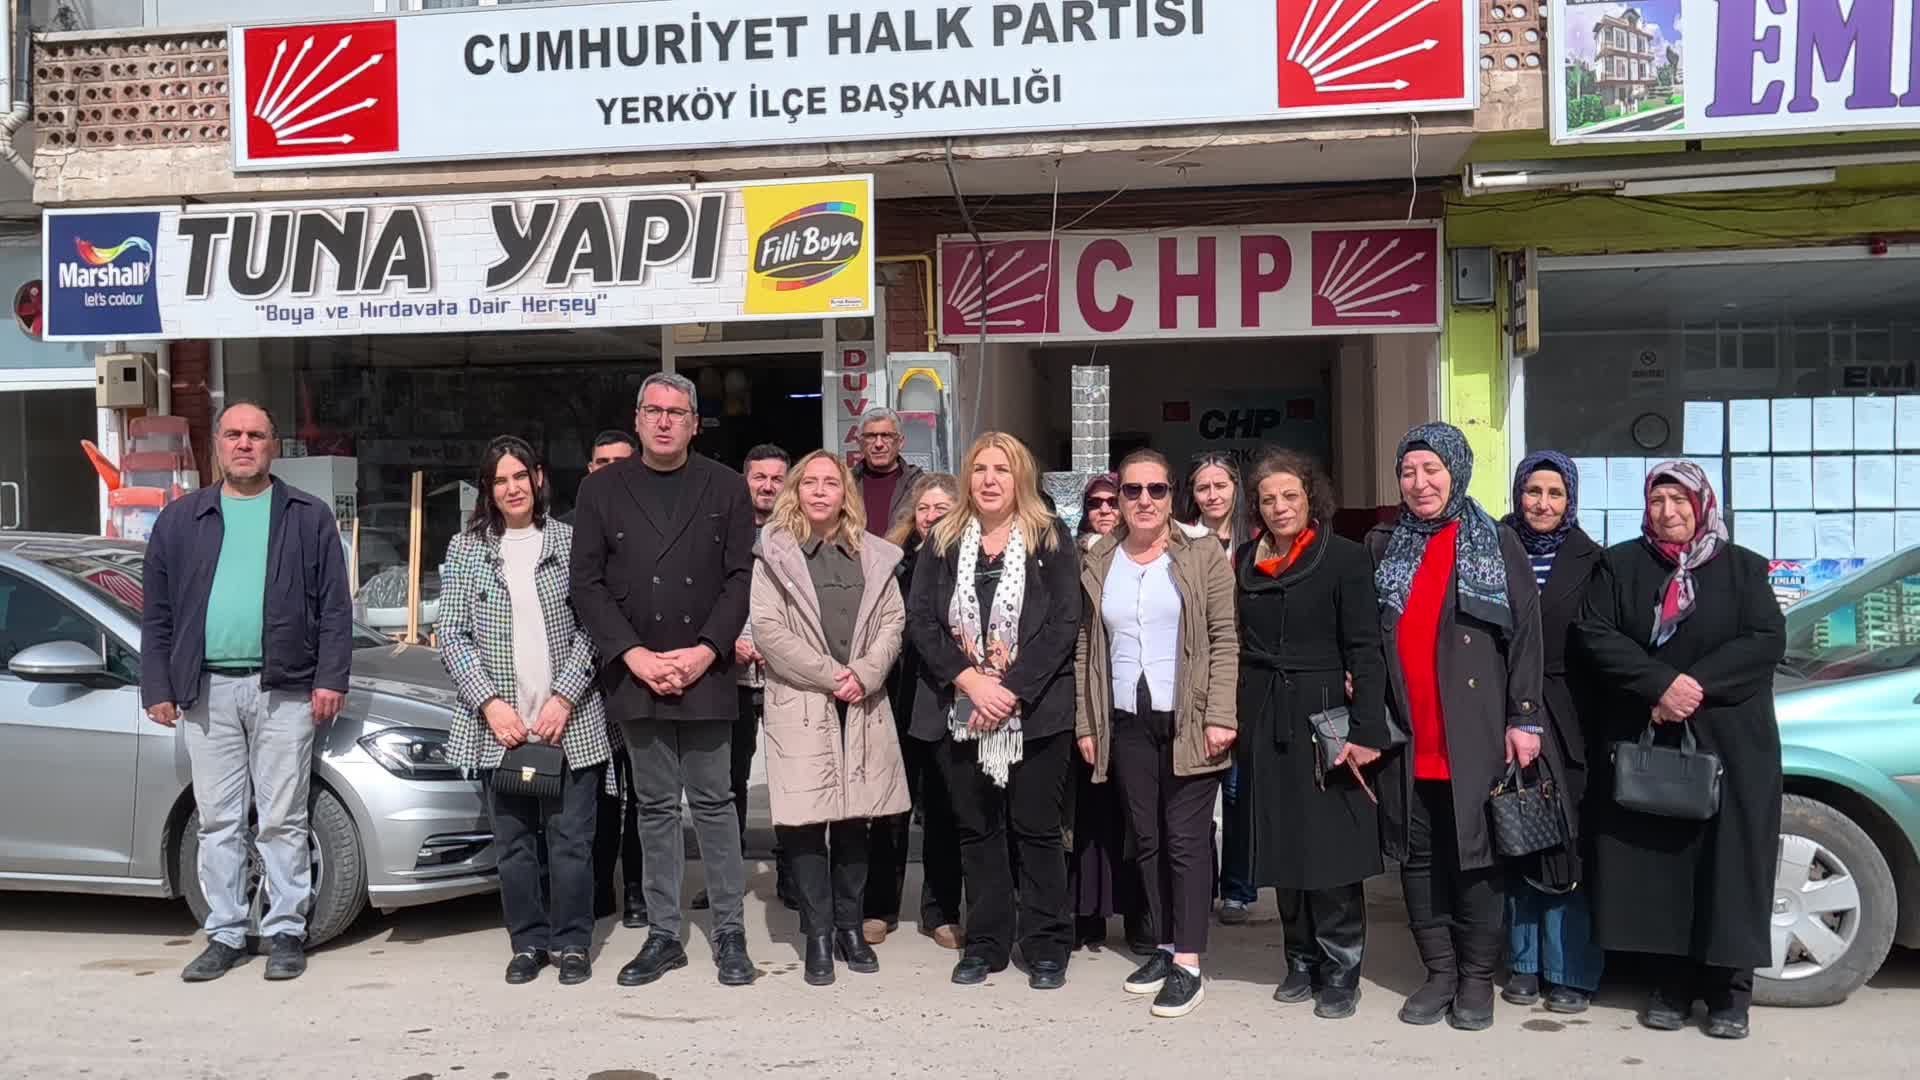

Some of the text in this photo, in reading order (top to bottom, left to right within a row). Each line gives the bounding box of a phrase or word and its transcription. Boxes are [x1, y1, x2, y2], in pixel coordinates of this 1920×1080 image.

[464, 12, 808, 75] CUMHURİYET
[828, 6, 974, 55] HALK
[596, 68, 1062, 125] YERKÖY İLÇE BAŞKANLIĞI
[177, 193, 726, 299] TUNA YAPI
[761, 226, 859, 267] Filli Boya
[58, 261, 145, 288] Marshall
[1076, 234, 1293, 333] CHP
[84, 291, 144, 306] let's colour
[326, 305, 349, 319] ve
[360, 300, 458, 318] Hırdavata
[470, 297, 511, 315] Dair
[1199, 407, 1281, 440] CHP
